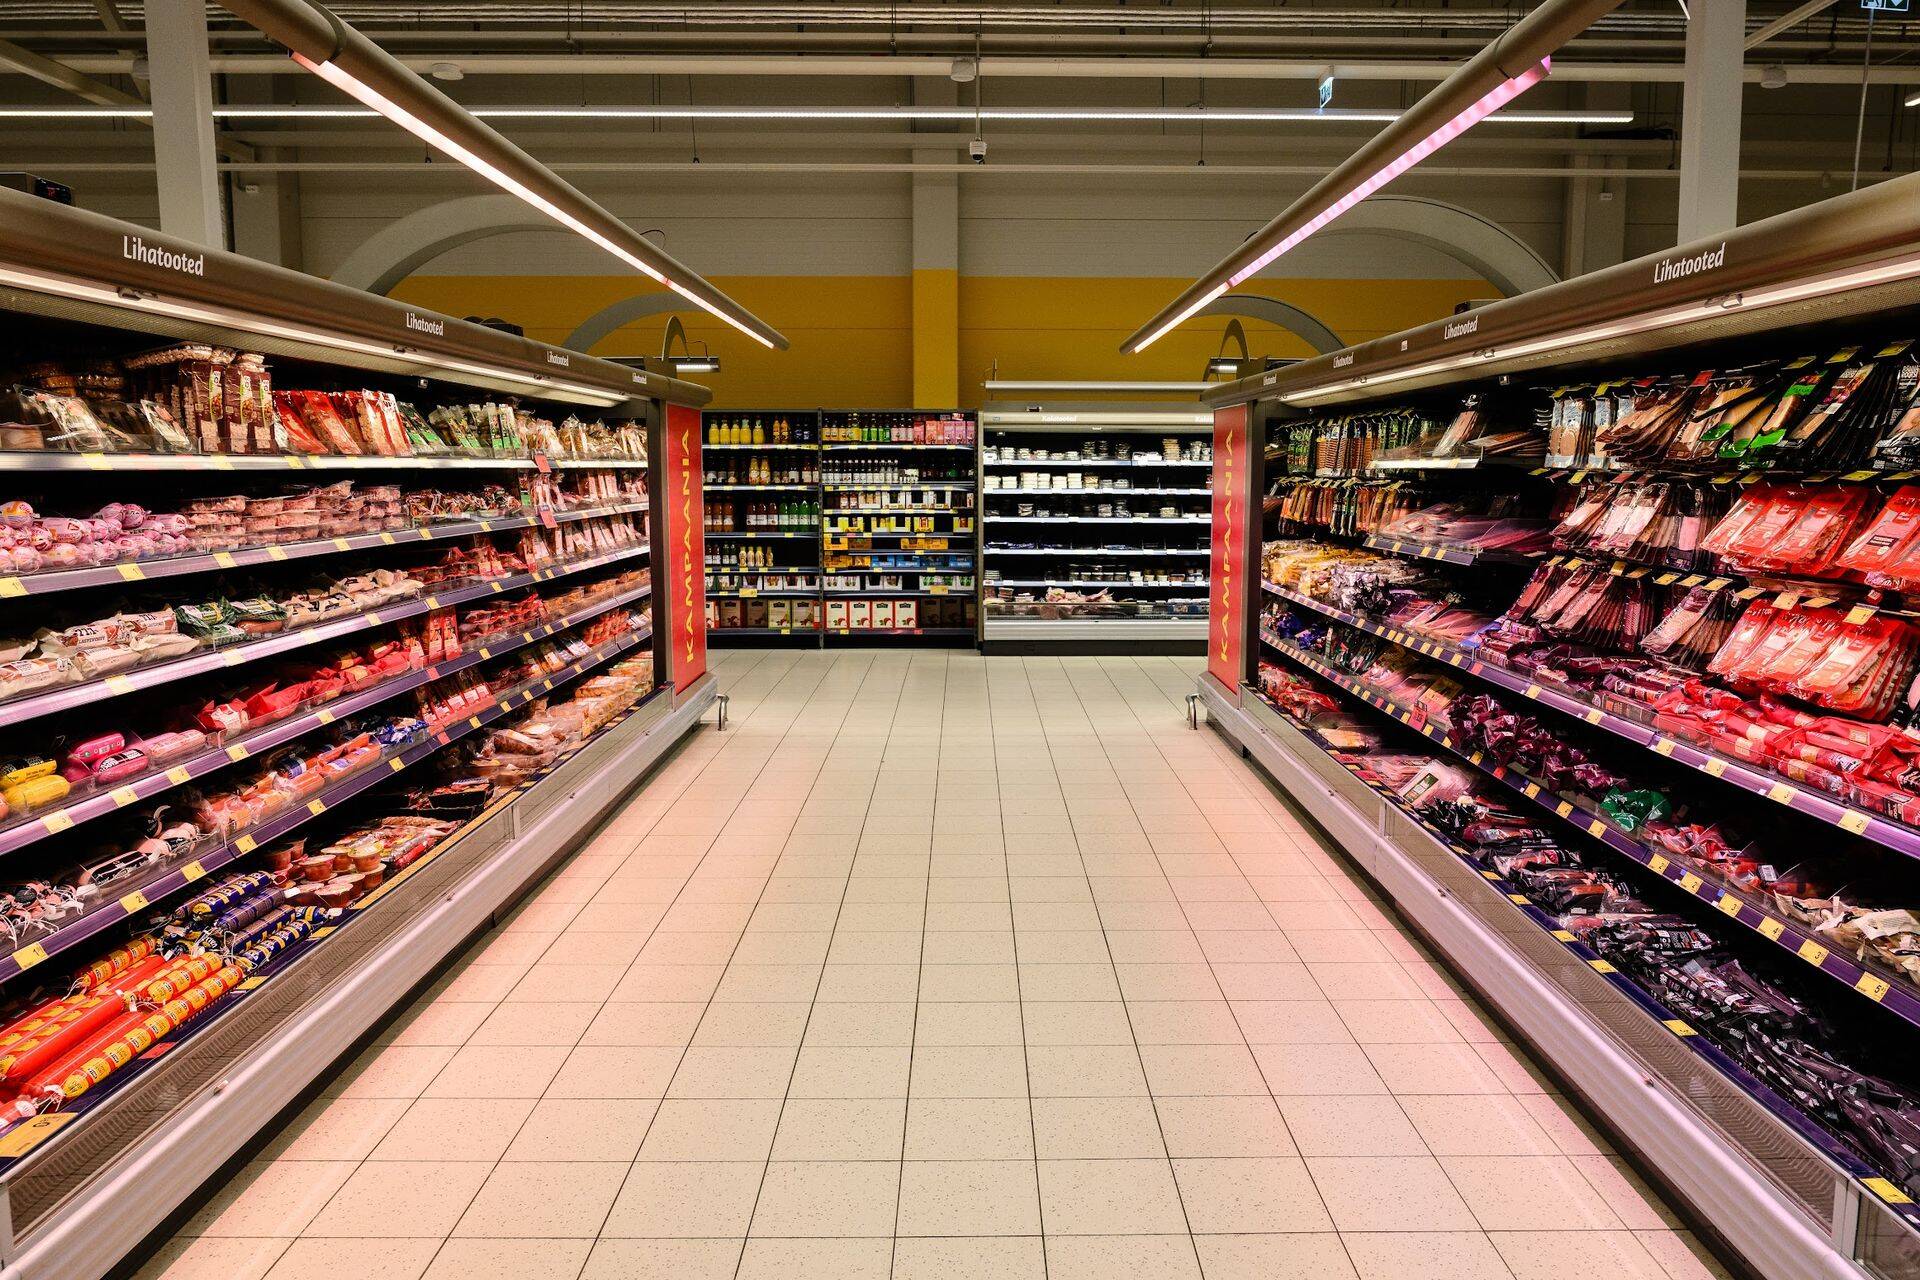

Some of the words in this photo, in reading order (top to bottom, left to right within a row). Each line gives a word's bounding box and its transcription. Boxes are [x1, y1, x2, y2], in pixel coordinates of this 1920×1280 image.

[123, 235, 204, 276] Lihatooted
[1653, 241, 1726, 284] Lihatooted
[406, 312, 444, 337] Lihatooted
[1444, 315, 1479, 340] Lihatooted
[546, 350, 569, 367] Lihatooted
[1333, 352, 1354, 369] Lihatooted
[682, 429, 694, 663] KAMPAANIA
[1220, 430, 1233, 662] KAMPAANIA
[1874, 984, 1882, 994] 5
